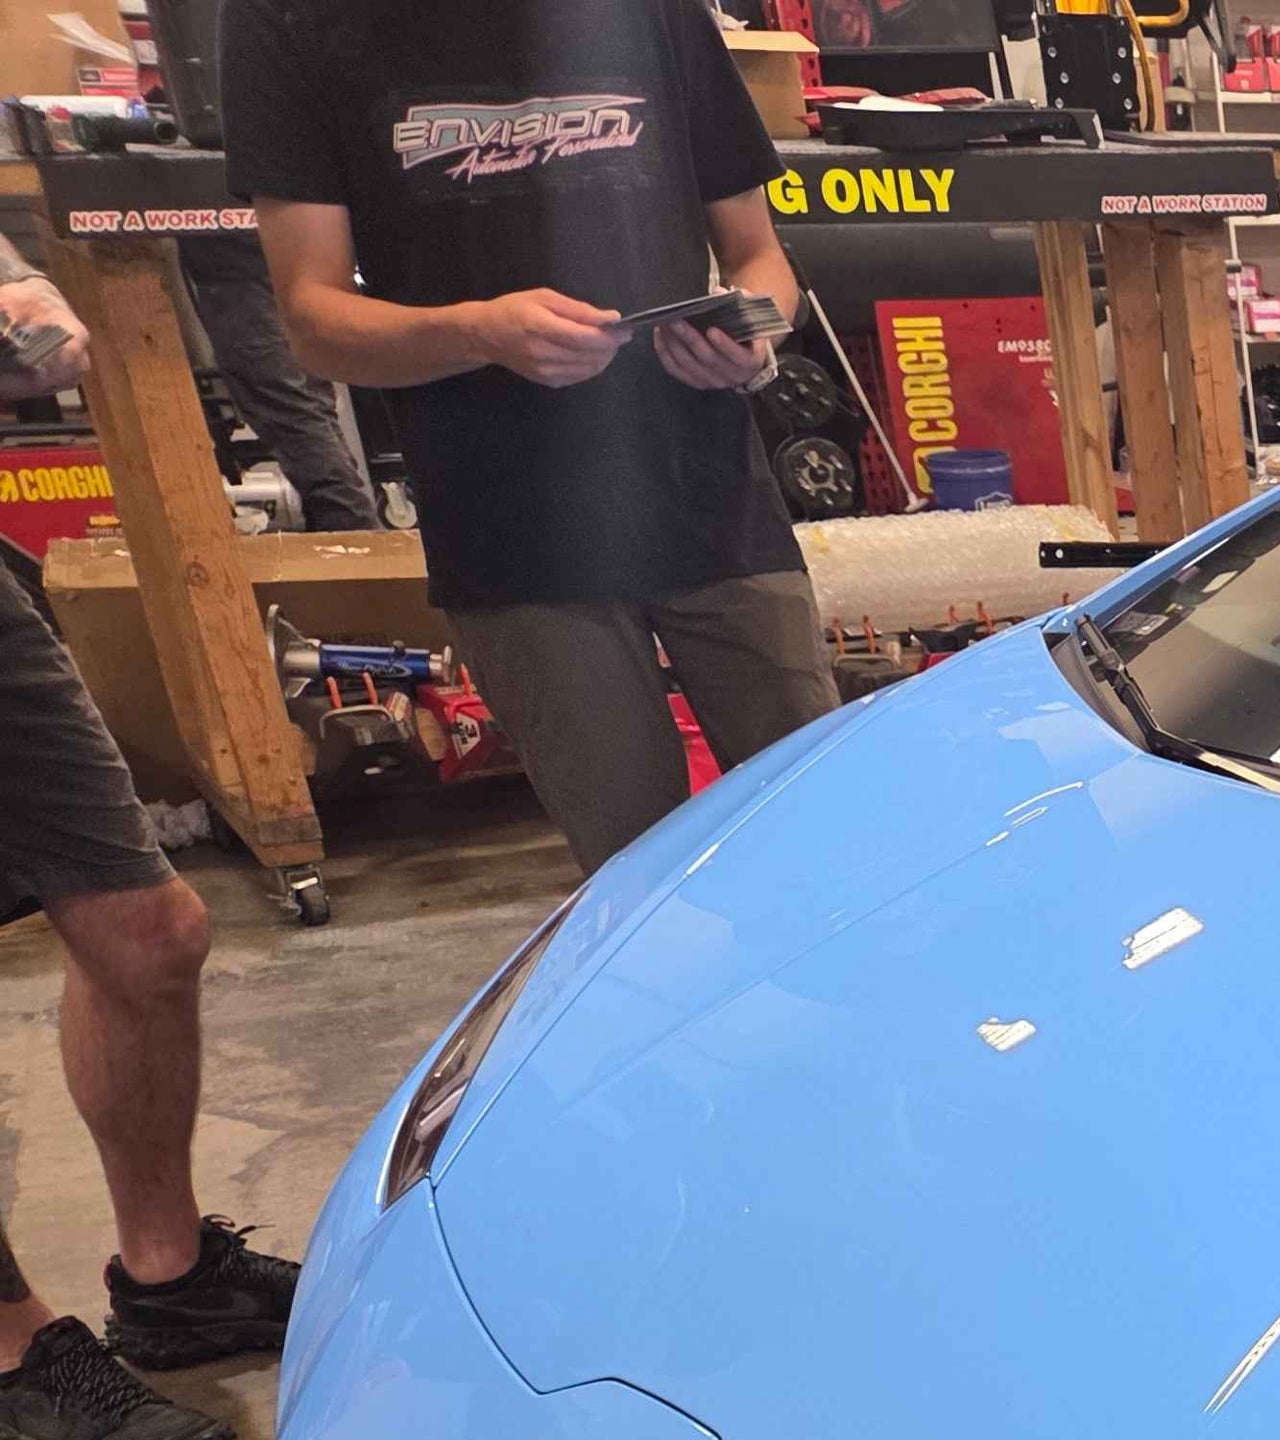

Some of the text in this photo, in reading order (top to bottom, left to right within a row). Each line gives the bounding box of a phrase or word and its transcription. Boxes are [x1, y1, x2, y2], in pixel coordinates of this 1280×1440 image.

[821, 168, 955, 213] ONLY
[1101, 194, 1267, 213] NOT A WORK STATION
[70, 211, 121, 232] NOT
[124, 211, 144, 231] A
[145, 210, 218, 231] WORK
[892, 317, 958, 442] CORGHI
[18, 465, 114, 502] CORGHI
